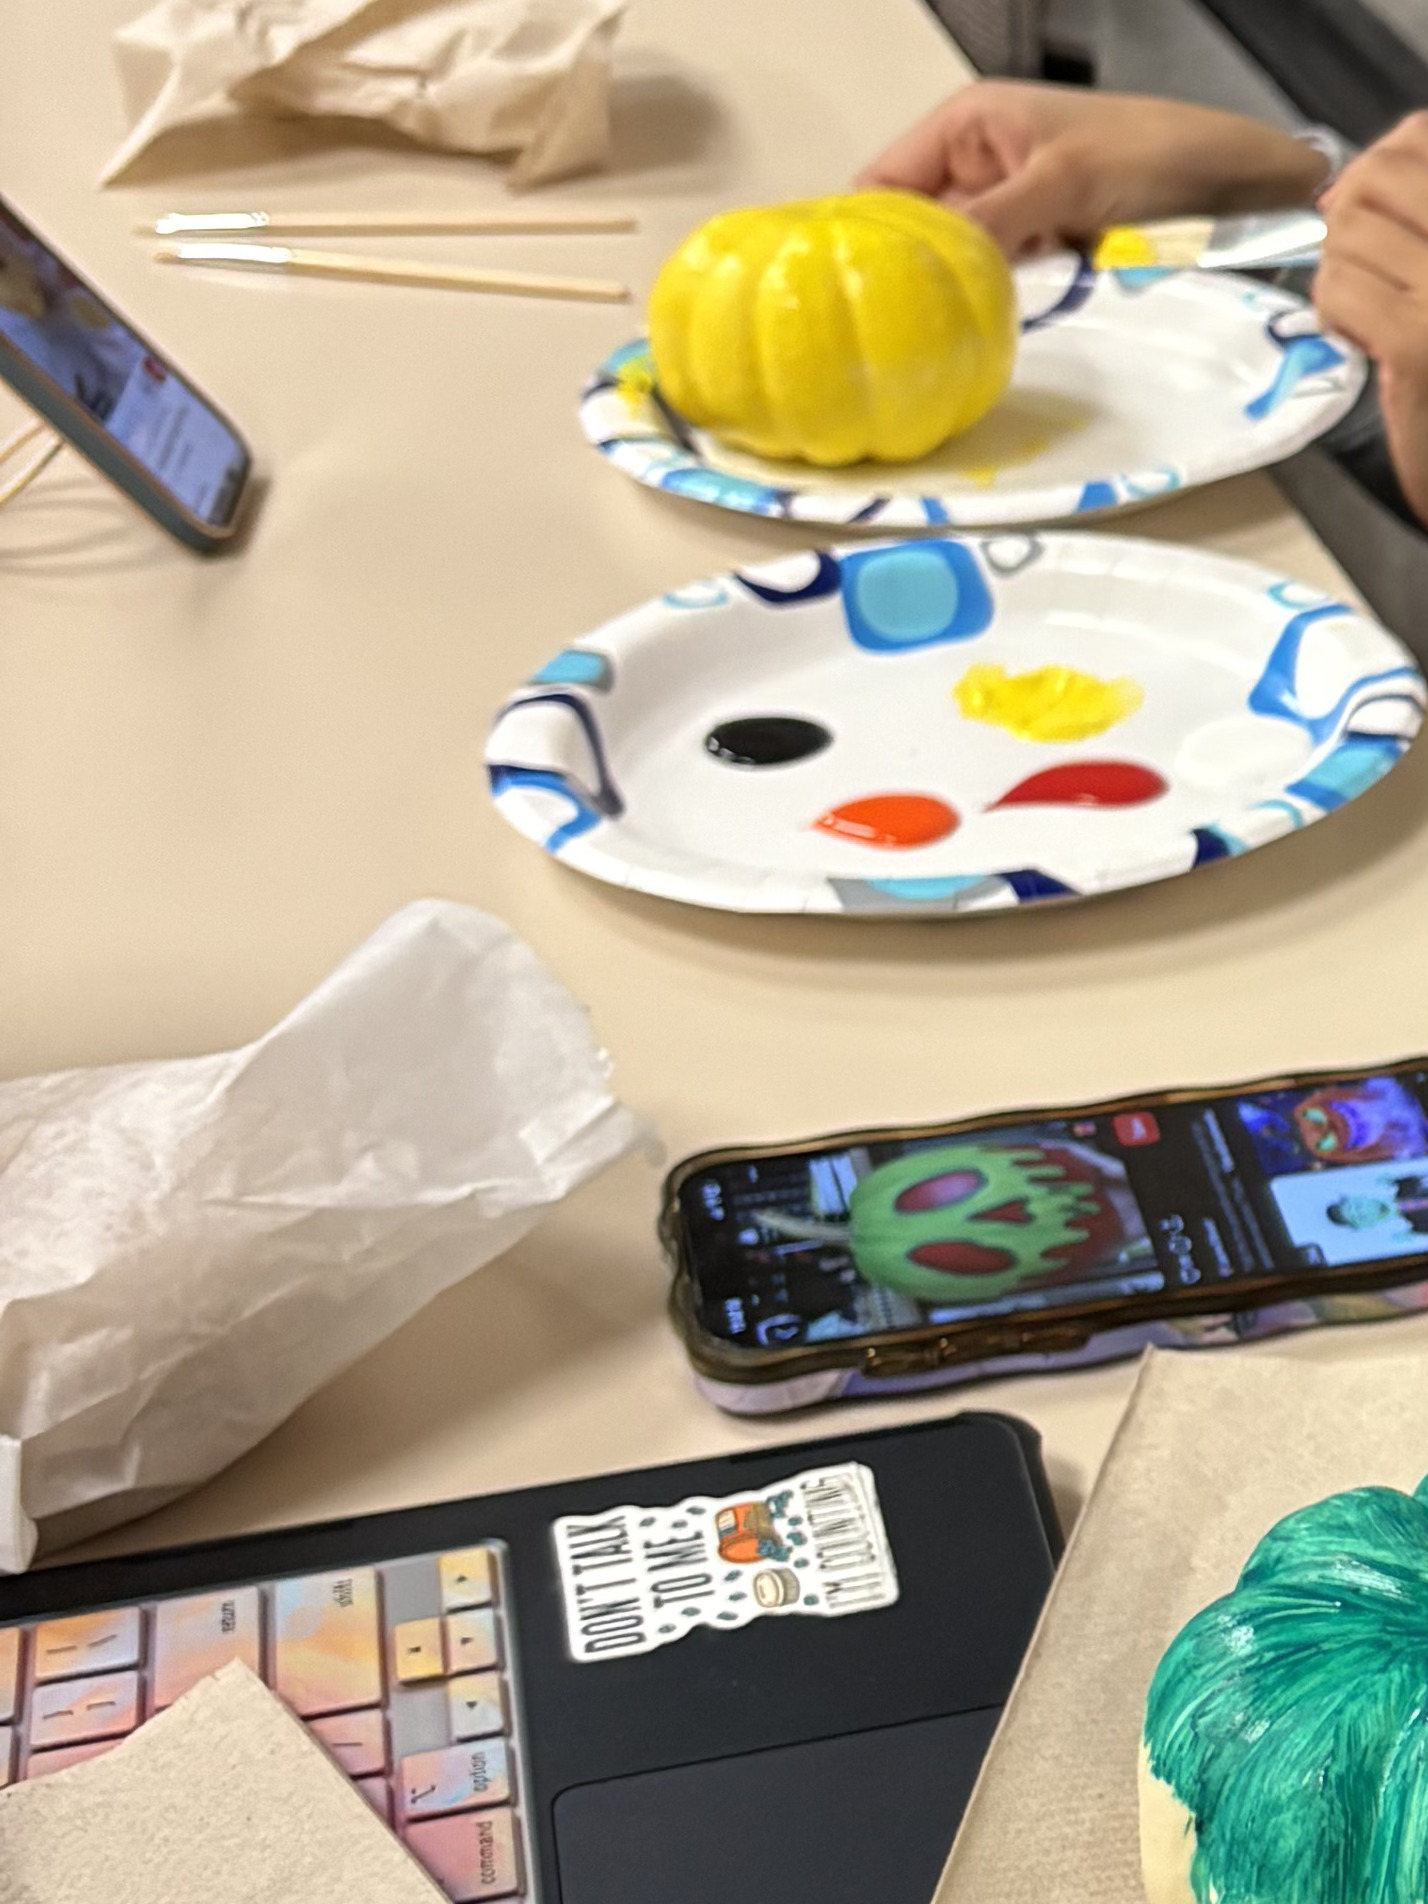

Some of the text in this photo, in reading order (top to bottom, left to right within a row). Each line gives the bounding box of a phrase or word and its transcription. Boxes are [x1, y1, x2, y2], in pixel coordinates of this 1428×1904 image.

[566, 1514, 647, 1654] DON'T TALK
[644, 1531, 716, 1609] TO ME
[471, 1752, 491, 1792] option
[476, 1820, 496, 1885] command
